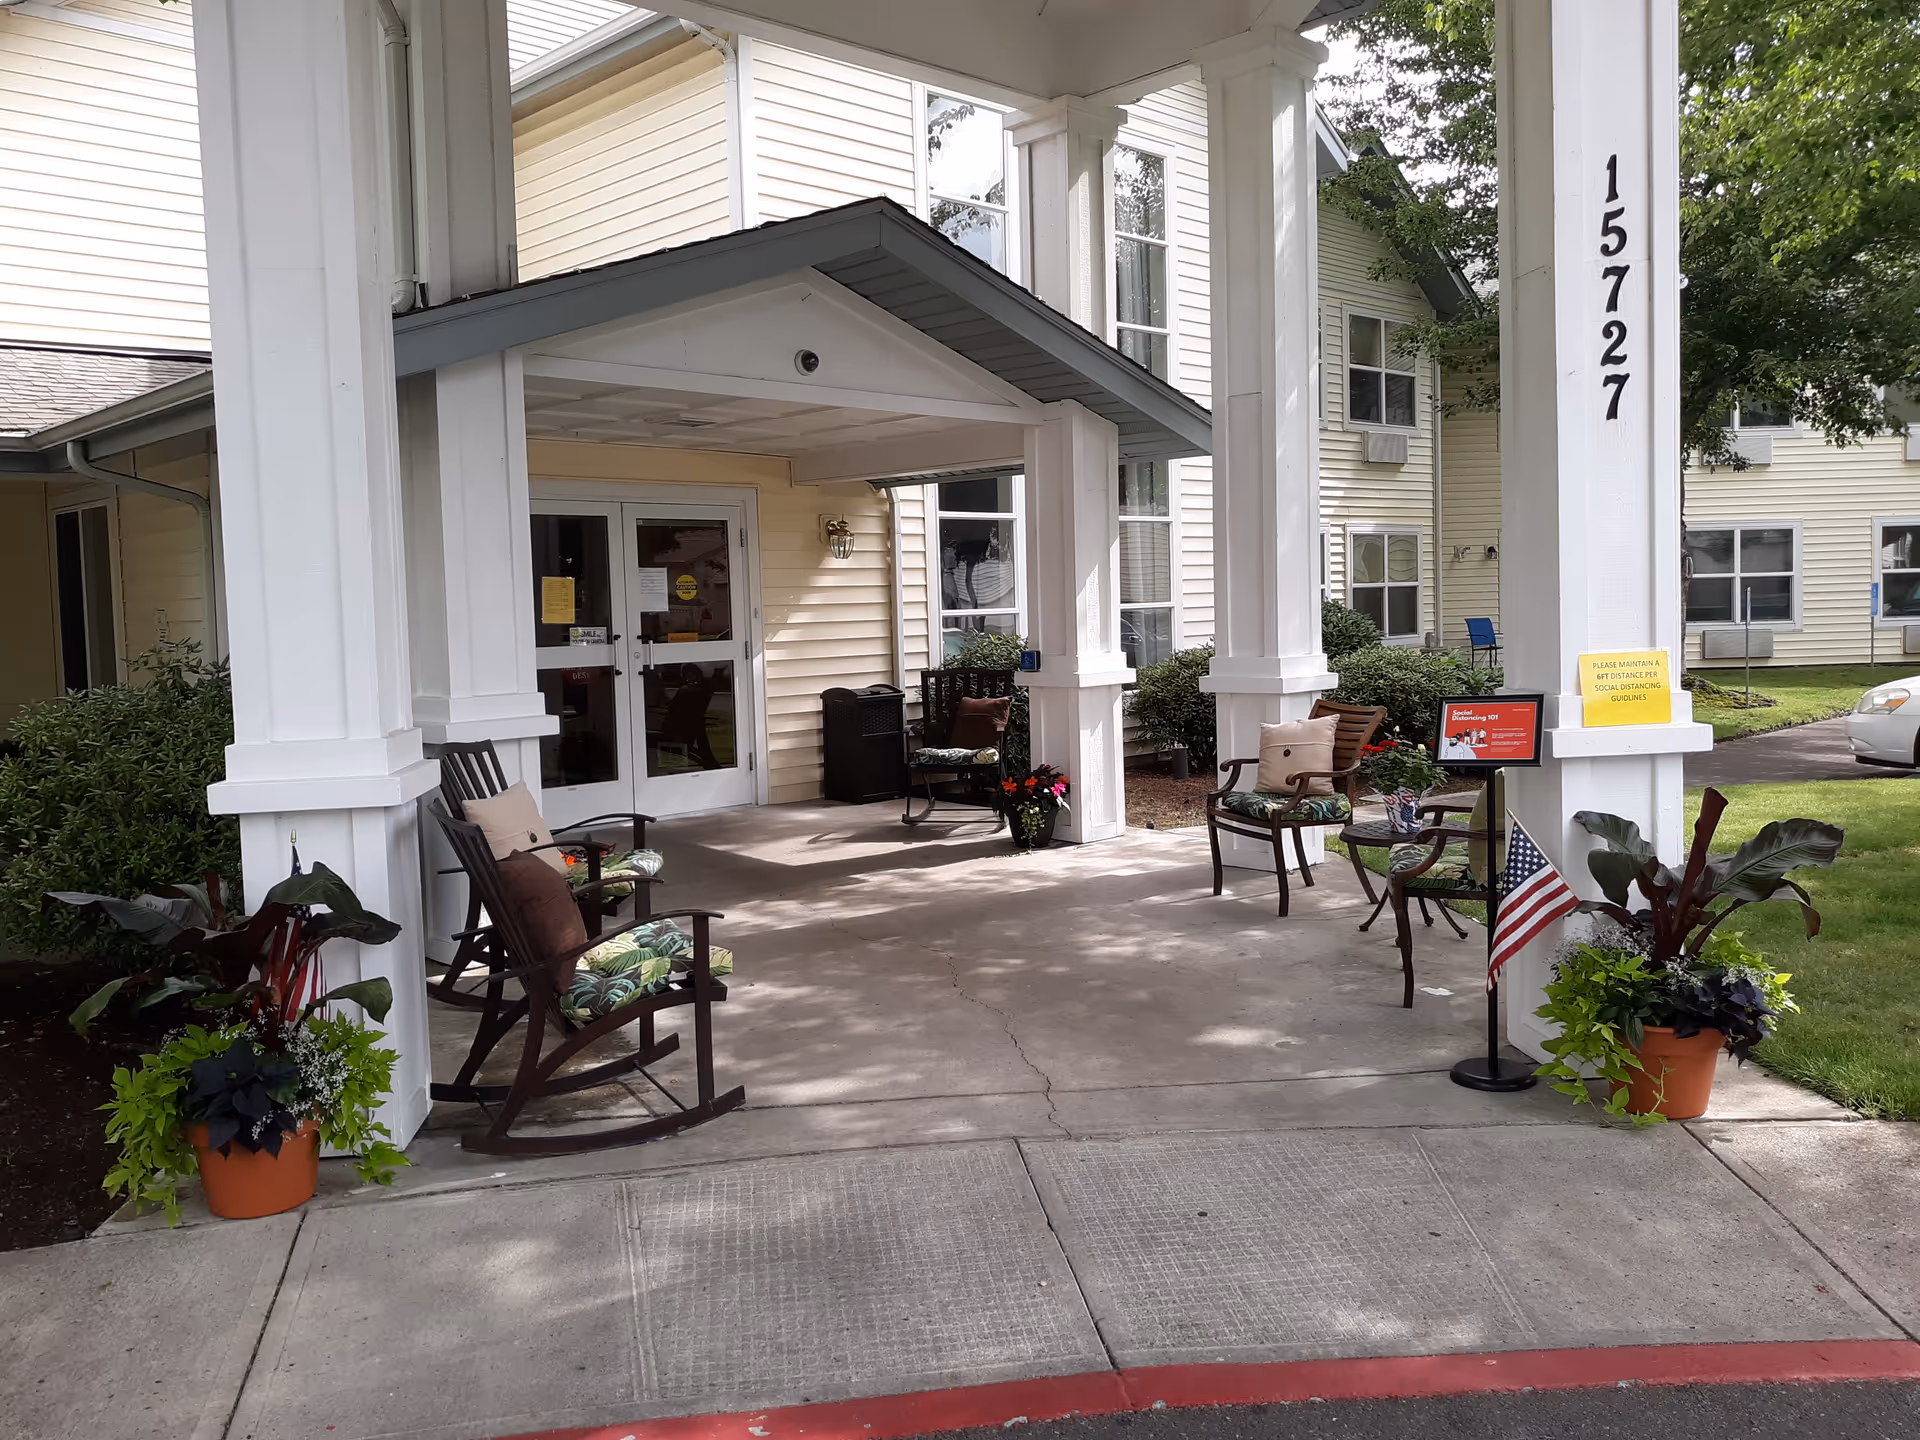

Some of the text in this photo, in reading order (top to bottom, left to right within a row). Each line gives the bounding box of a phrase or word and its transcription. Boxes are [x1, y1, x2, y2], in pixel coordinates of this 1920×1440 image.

[1600, 153, 1630, 421] 15727
[1592, 661, 1617, 669] PLEASE
[1619, 660, 1653, 668] MAINTAIN
[1610, 671, 1644, 680] DISTANCE
[1594, 682, 1661, 692] SOCIAL DISTANCING
[1611, 693, 1647, 702] GUIDLINES
